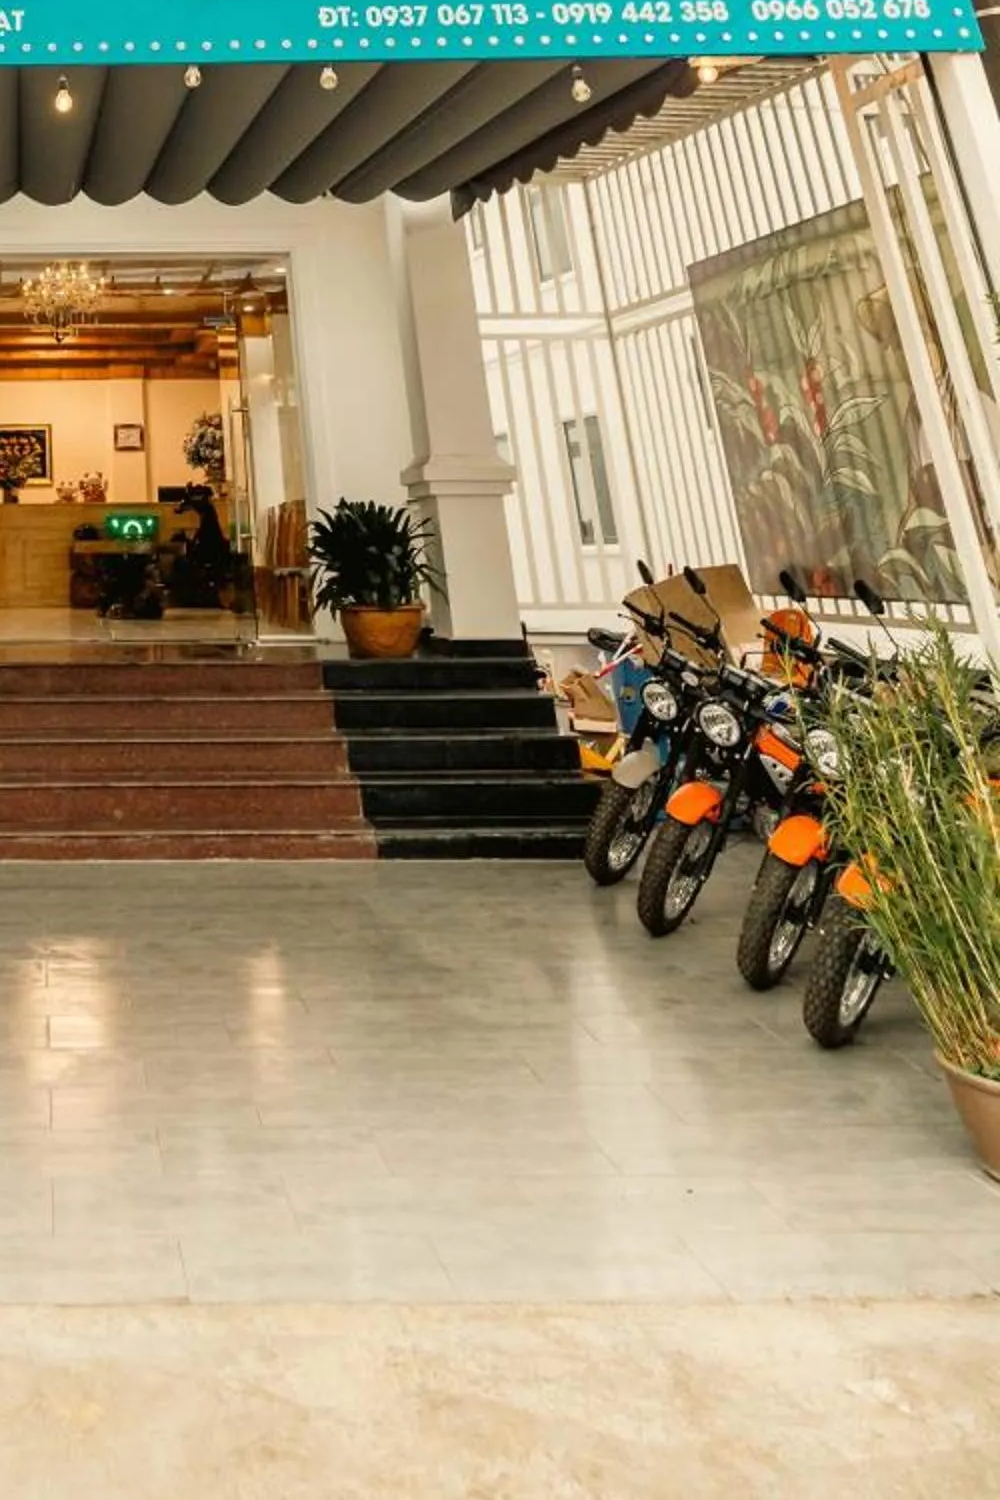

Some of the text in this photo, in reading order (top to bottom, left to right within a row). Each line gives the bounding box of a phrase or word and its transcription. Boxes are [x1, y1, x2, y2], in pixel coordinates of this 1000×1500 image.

[318, 6, 359, 28] ĐT:
[365, 5, 429, 27] 0937
[437, 3, 485, 26] 067
[491, 2, 529, 25] 113
[552, 2, 612, 24] 0919
[621, 1, 673, 23] 442
[680, 0, 729, 22] 358
[752, 0, 819, 21] 0966
